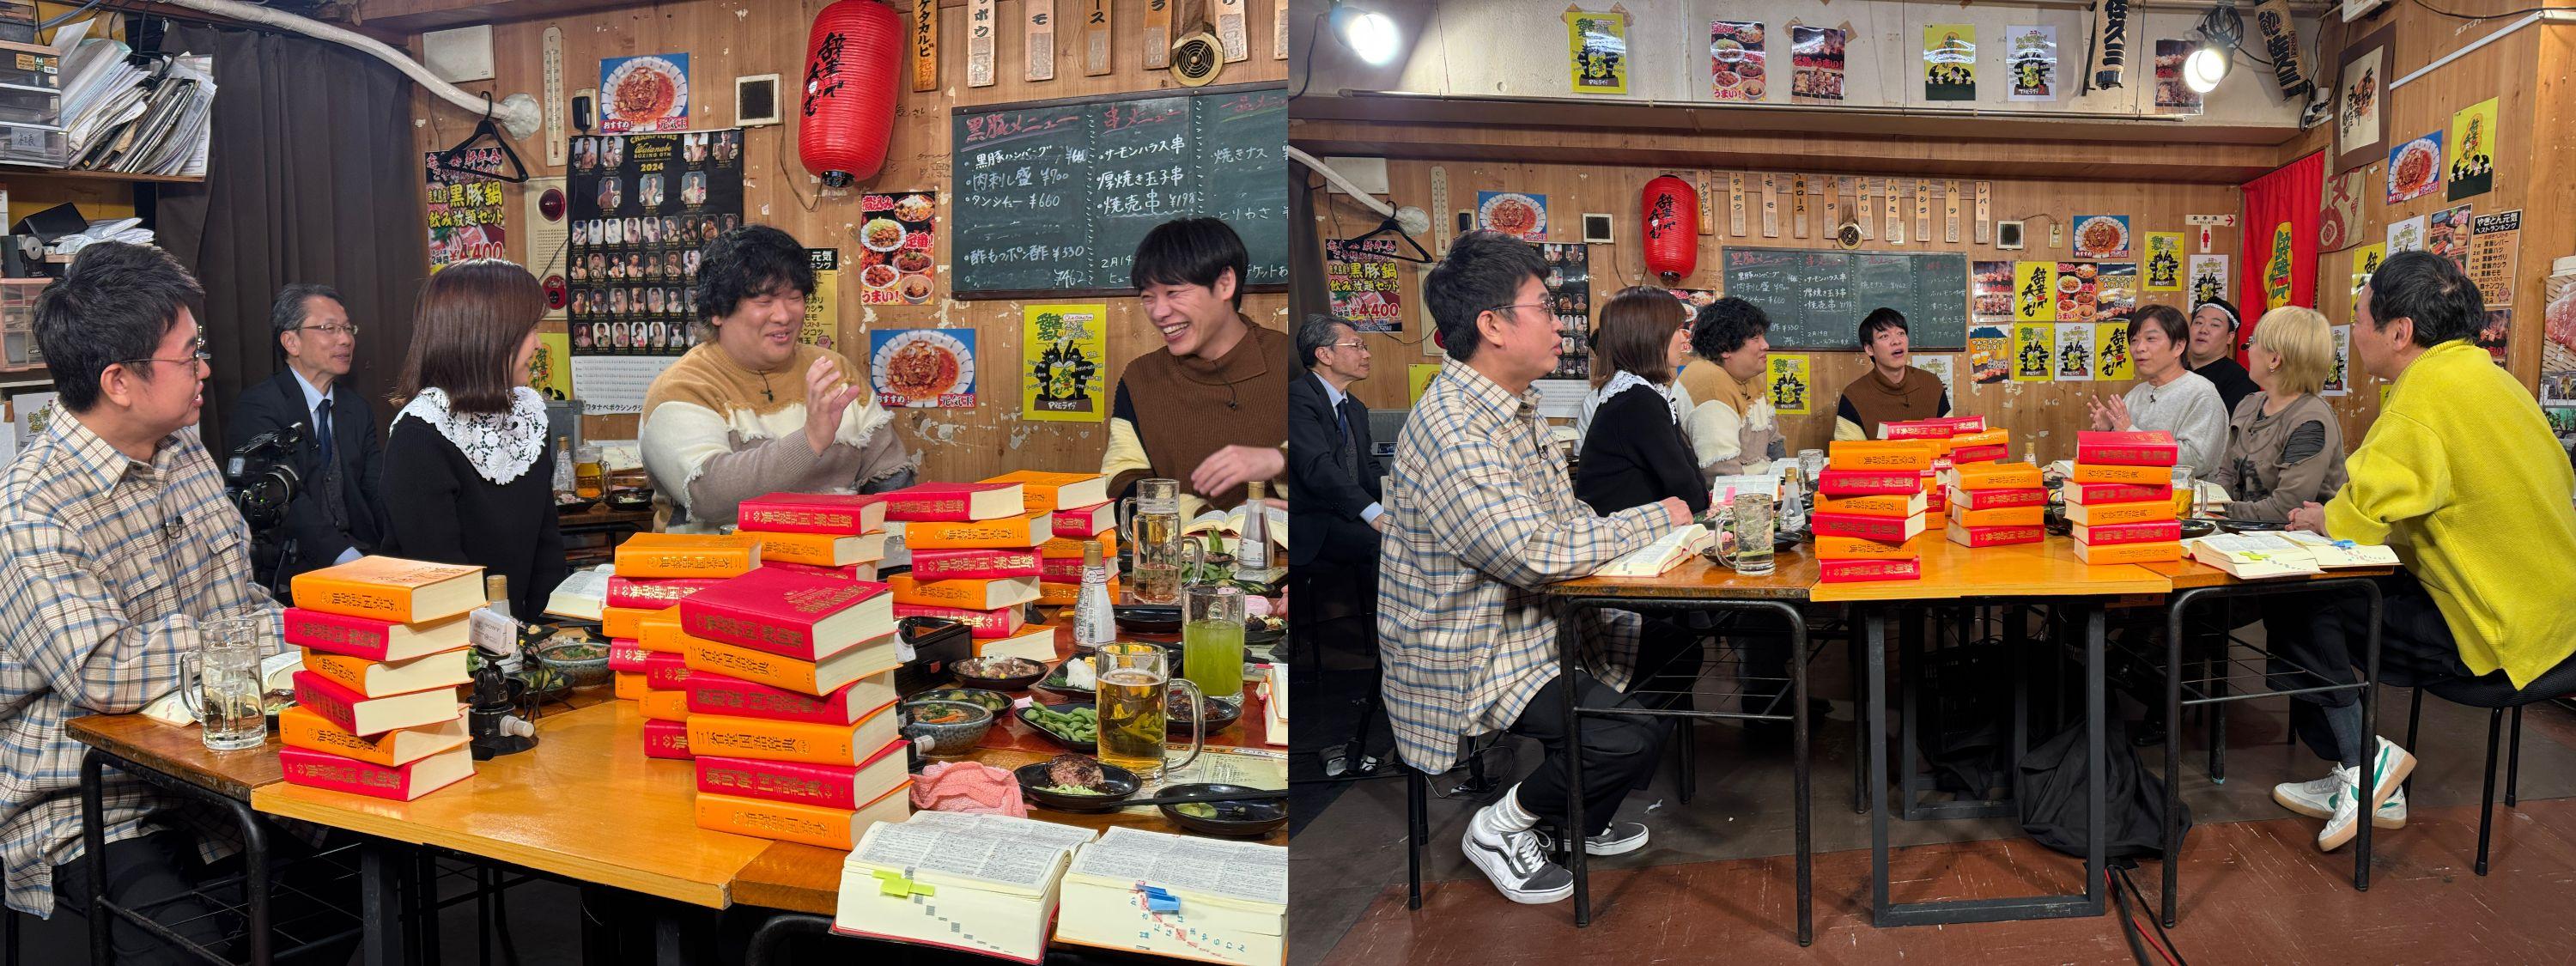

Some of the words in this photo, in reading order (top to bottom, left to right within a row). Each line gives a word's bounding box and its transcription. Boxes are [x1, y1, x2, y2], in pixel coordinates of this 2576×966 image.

[1714, 89, 1743, 99] うまい!
[975, 145, 1052, 169] 黒豚ハンバーグ
[1213, 147, 1268, 164] 焼きナス
[973, 167, 1032, 191] 肉刺し盛
[1098, 166, 1184, 190] 厚焼き玉子串
[449, 181, 502, 207] 黒豚鍋
[972, 196, 1023, 209] タンシチュー
[1030, 193, 1060, 209] ¥660
[1104, 189, 1160, 214] 焼売串
[1734, 179, 1742, 210] テッポウ
[1765, 179, 1774, 209] モモ
[1949, 186, 1957, 214] ハツ
[862, 195, 894, 211] 煮込み
[428, 209, 503, 228] 飲み放題セット
[2477, 213, 2518, 227] やきとん元気
[2476, 223, 2516, 234] ベストランキング
[906, 233, 934, 248] 定番!
[811, 251, 832, 261] 元気
[1053, 246, 1084, 261] ¥330
[1350, 262, 1398, 279] 黒豚鍋
[1330, 280, 1399, 292] 飲み放題セット
[861, 291, 899, 304] うまい!
[696, 730, 796, 755] 三省堂国語辞典
